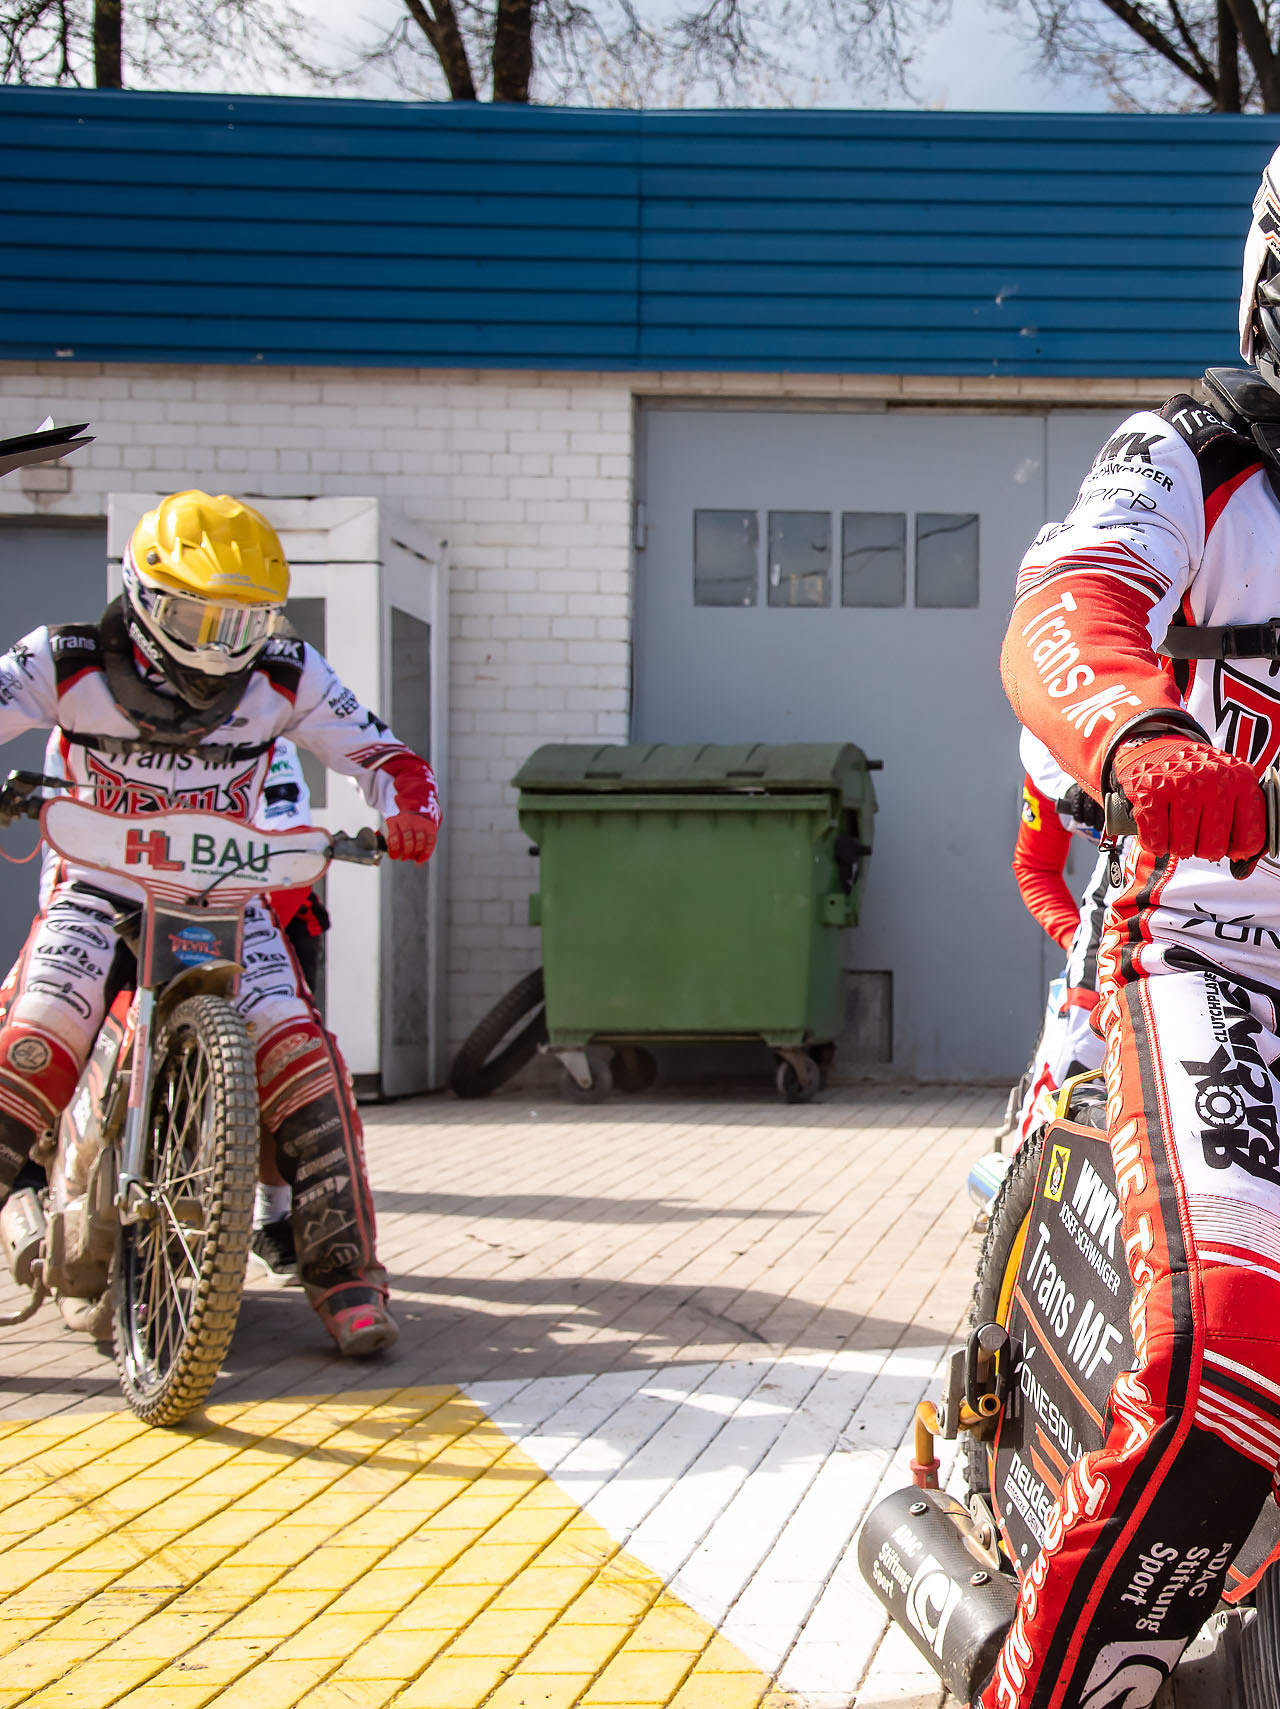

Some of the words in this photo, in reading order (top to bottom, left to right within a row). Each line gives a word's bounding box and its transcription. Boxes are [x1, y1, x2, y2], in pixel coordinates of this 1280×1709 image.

[49, 635, 97, 653] Trans
[1022, 592, 1095, 698] Trans
[1060, 684, 1142, 738] MF
[190, 834, 271, 873] BAU
[1071, 1158, 1124, 1260] WWK
[1059, 1201, 1080, 1237] JOSEF
[1074, 1227, 1121, 1297] SCHWAIGER
[1026, 1222, 1076, 1338] Trans
[1067, 1299, 1124, 1380] MF
[1020, 1363, 1087, 1463] ONESOLA
[873, 1560, 895, 1599] Sport
[879, 1542, 912, 1593] Stiftung
[1120, 1542, 1179, 1606] Sport
[1135, 1546, 1211, 1633] Stiftung
[1188, 1543, 1233, 1597] ADAC
